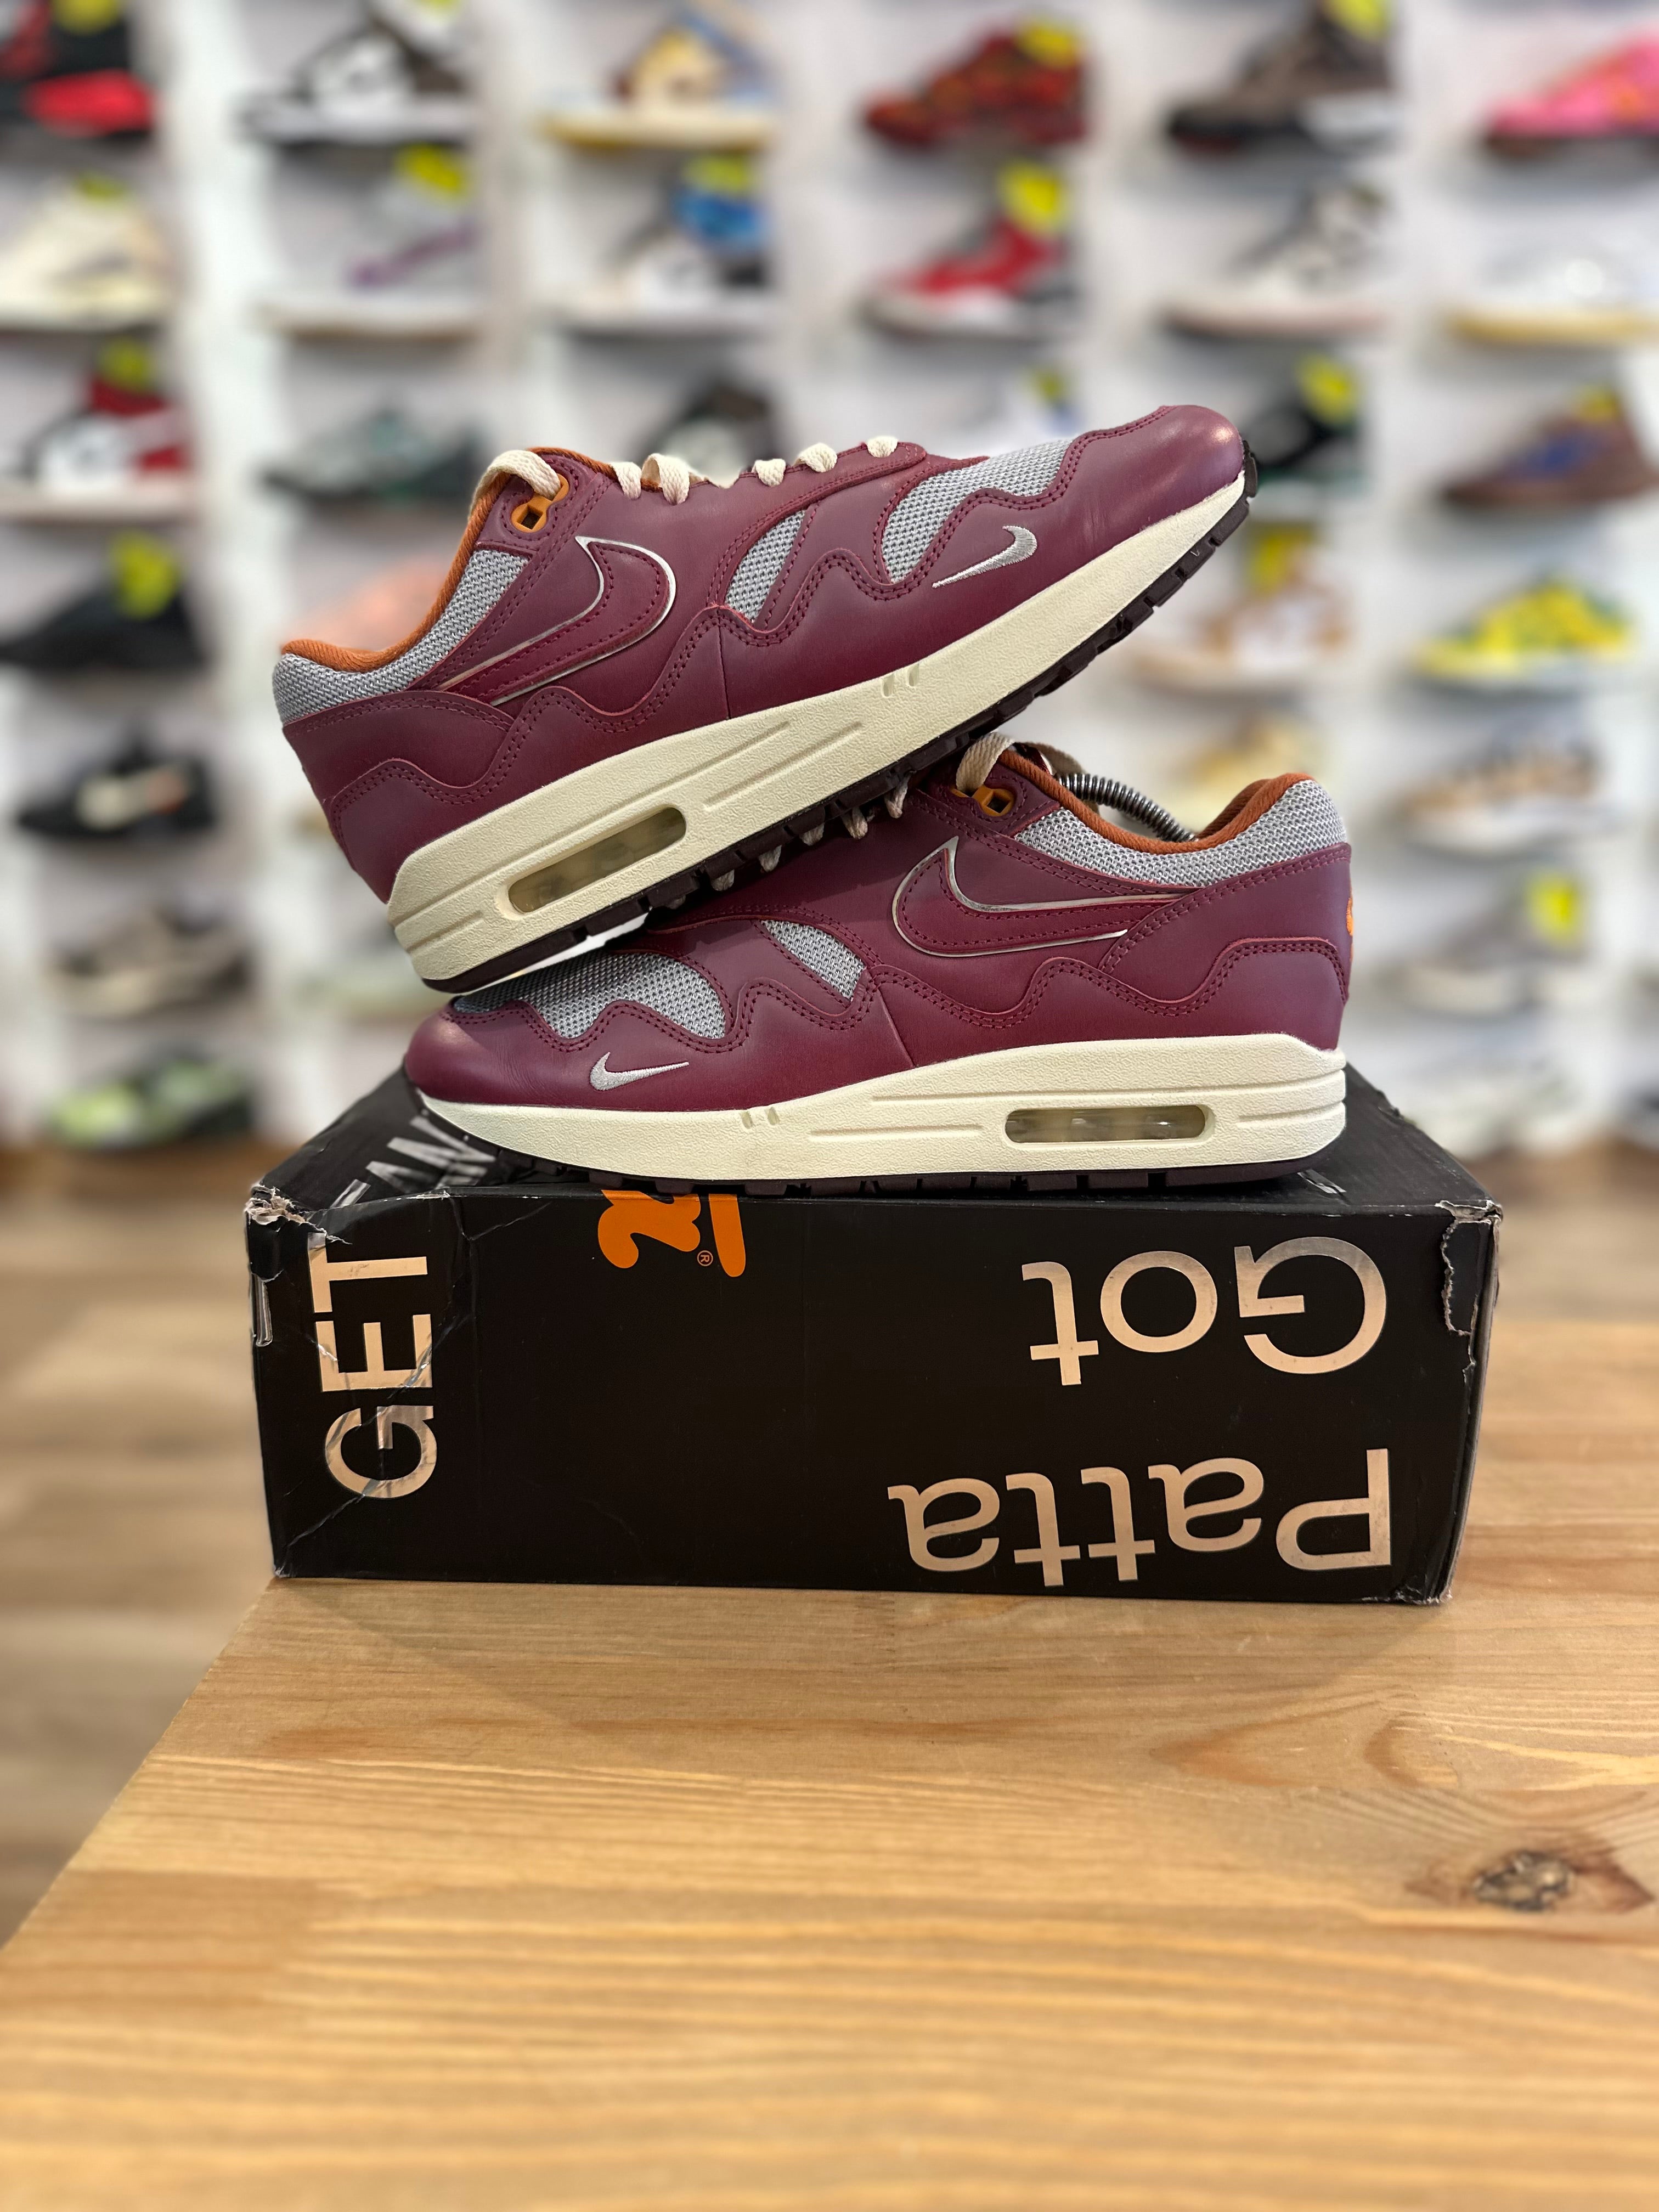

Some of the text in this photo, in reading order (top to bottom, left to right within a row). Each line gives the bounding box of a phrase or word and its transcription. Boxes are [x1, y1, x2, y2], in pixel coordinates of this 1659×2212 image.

[307, 1232, 437, 1499] GET
[1022, 1237, 1387, 1386] Got
[887, 1448, 1392, 1587] Patta
